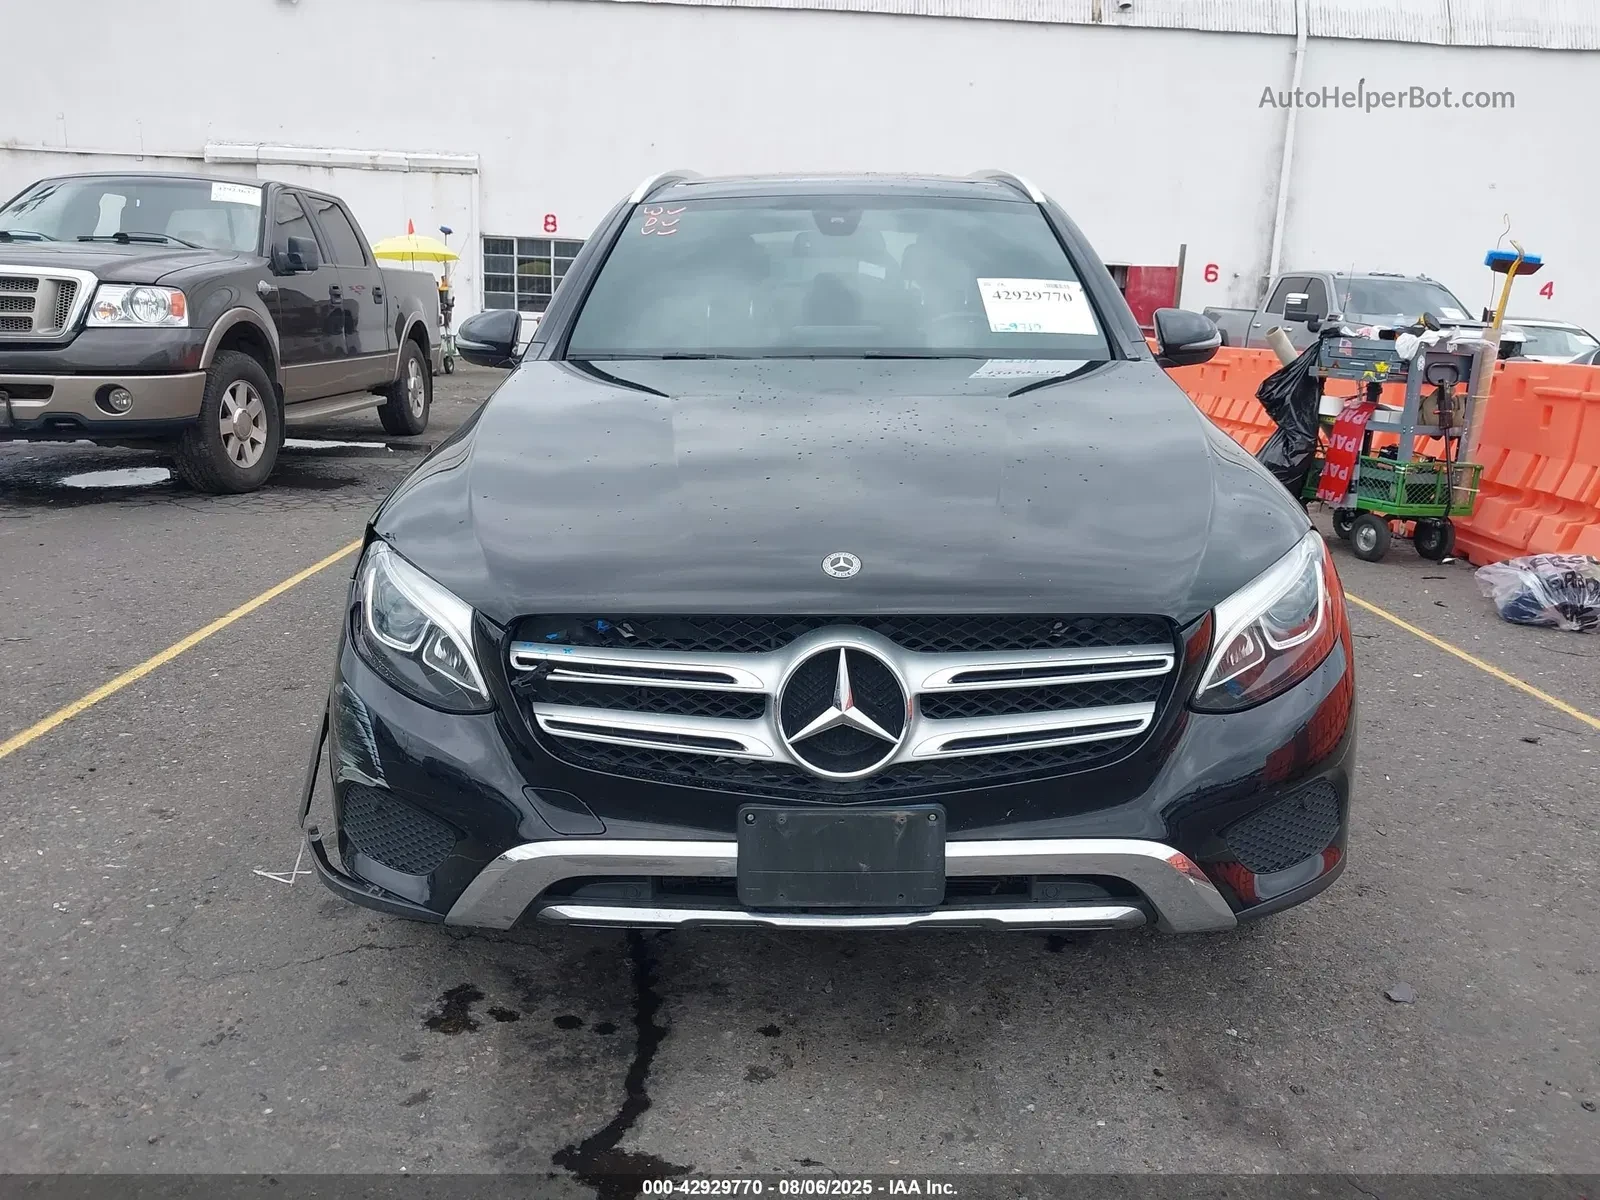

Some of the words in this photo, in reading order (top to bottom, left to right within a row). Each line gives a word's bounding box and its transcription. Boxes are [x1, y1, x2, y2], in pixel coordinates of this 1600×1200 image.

[543, 213, 557, 233] 8
[1204, 263, 1219, 283] 6
[992, 289, 1073, 302] 42929770
[1539, 281, 1553, 300] 4
